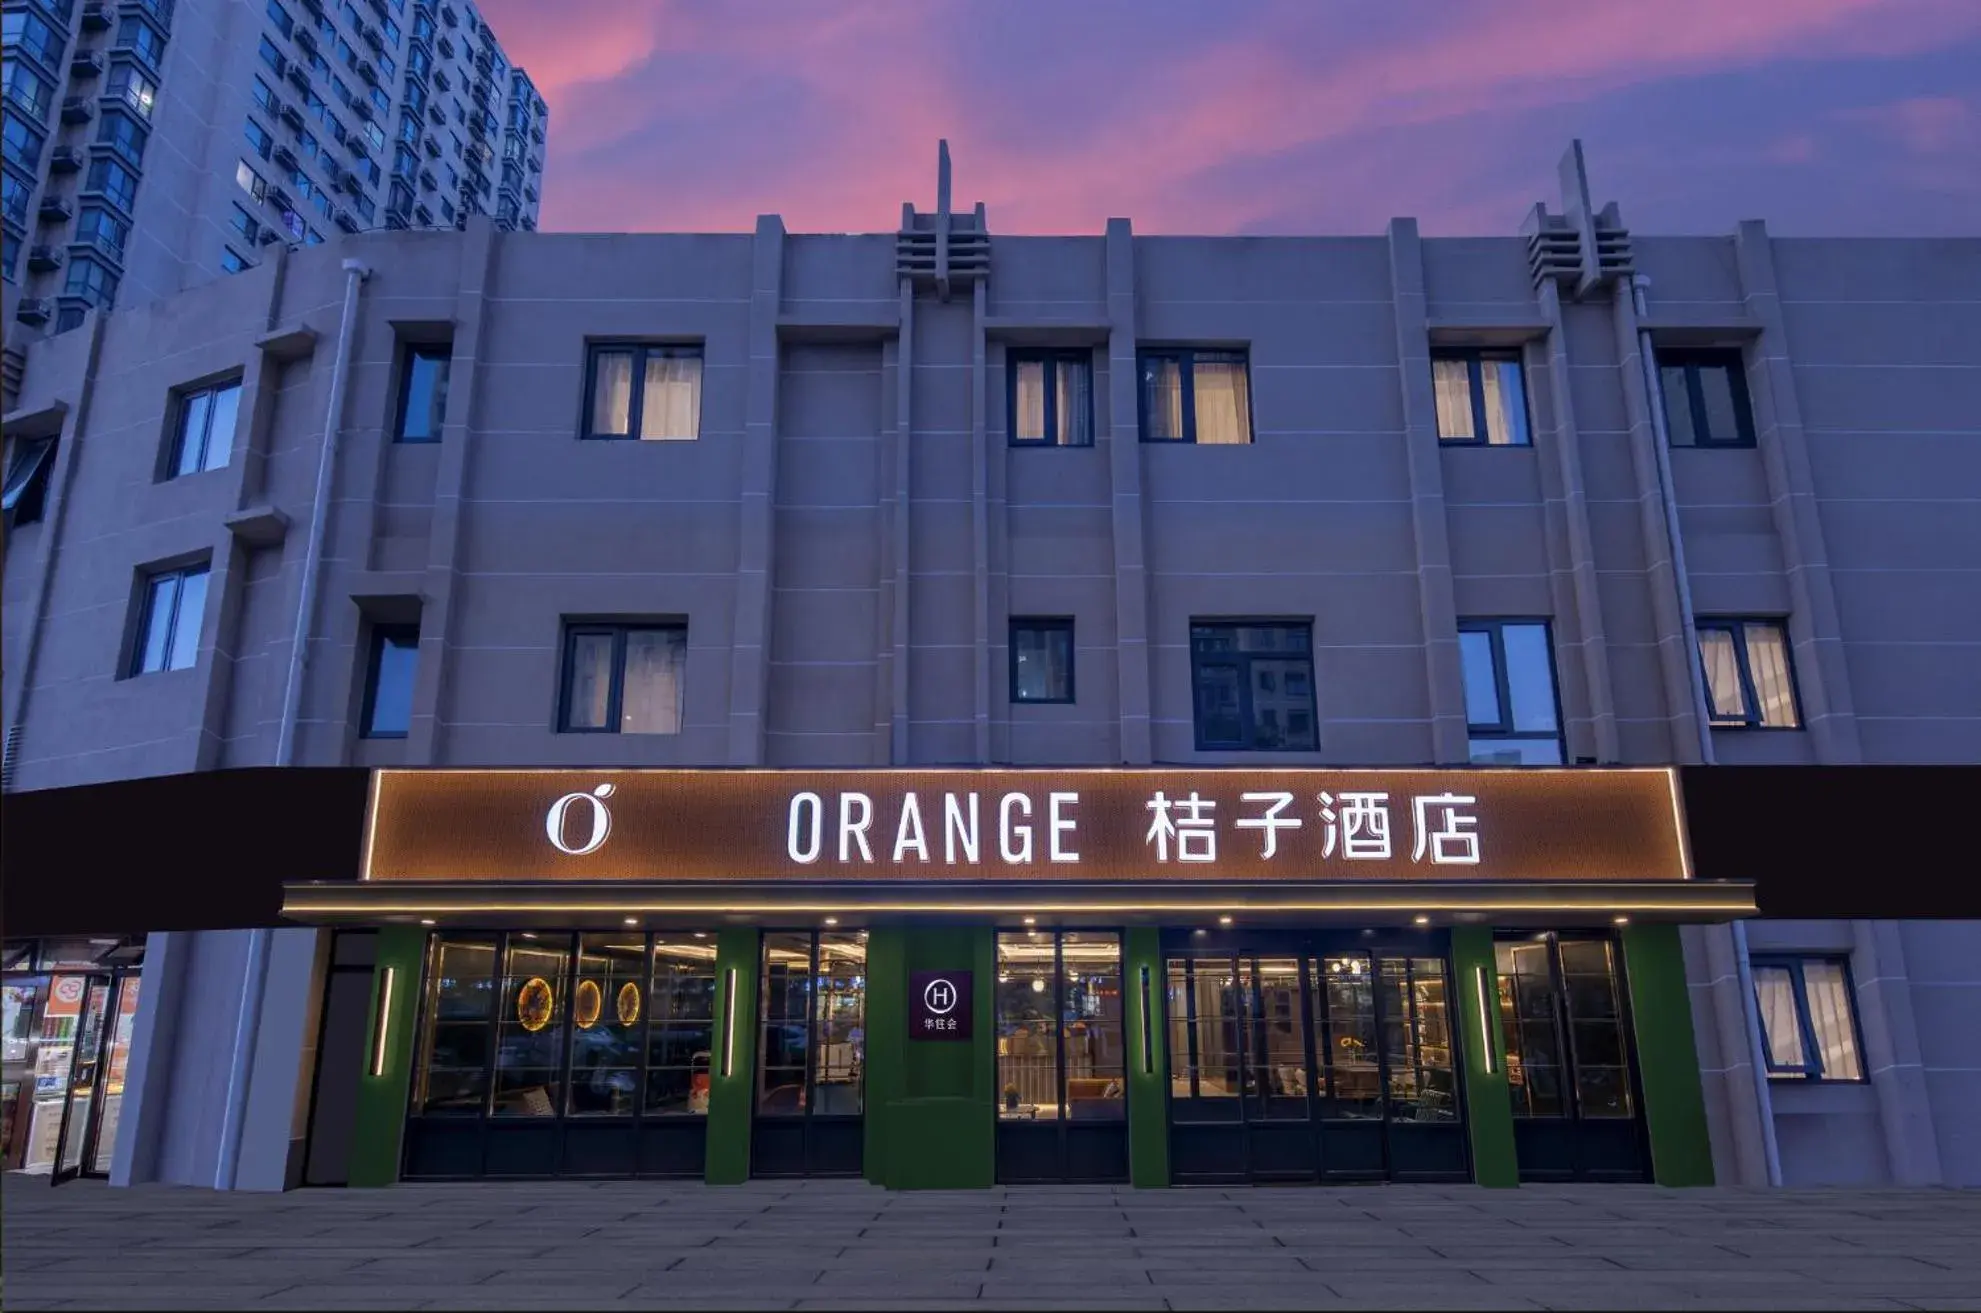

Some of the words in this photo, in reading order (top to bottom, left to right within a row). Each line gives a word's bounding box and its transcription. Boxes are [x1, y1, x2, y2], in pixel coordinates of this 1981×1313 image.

[787, 791, 1080, 864] ORANGE
[1145, 790, 1481, 865] 桔子酒店
[924, 1018, 957, 1030] 华住会
